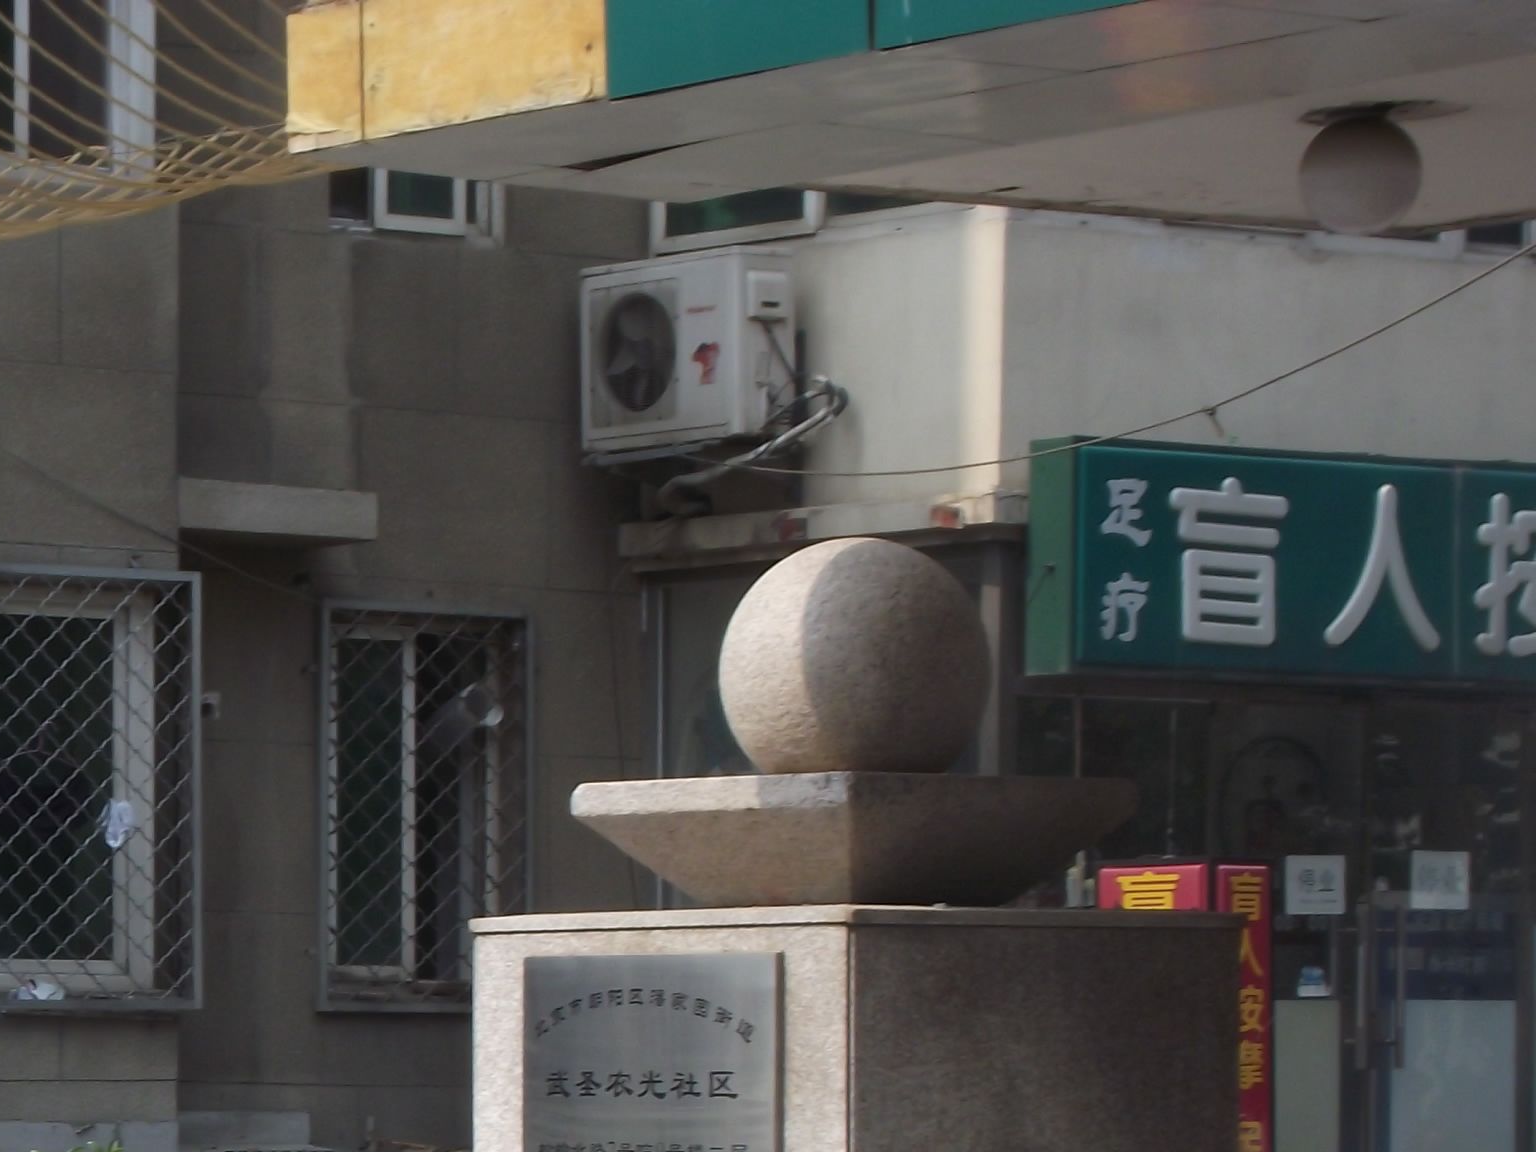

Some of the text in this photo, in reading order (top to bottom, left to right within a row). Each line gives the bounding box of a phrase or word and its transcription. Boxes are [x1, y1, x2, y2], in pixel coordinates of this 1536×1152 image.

[1100, 478, 1154, 643] 足疗
[545, 1069, 739, 1100] 武圣农光社区
